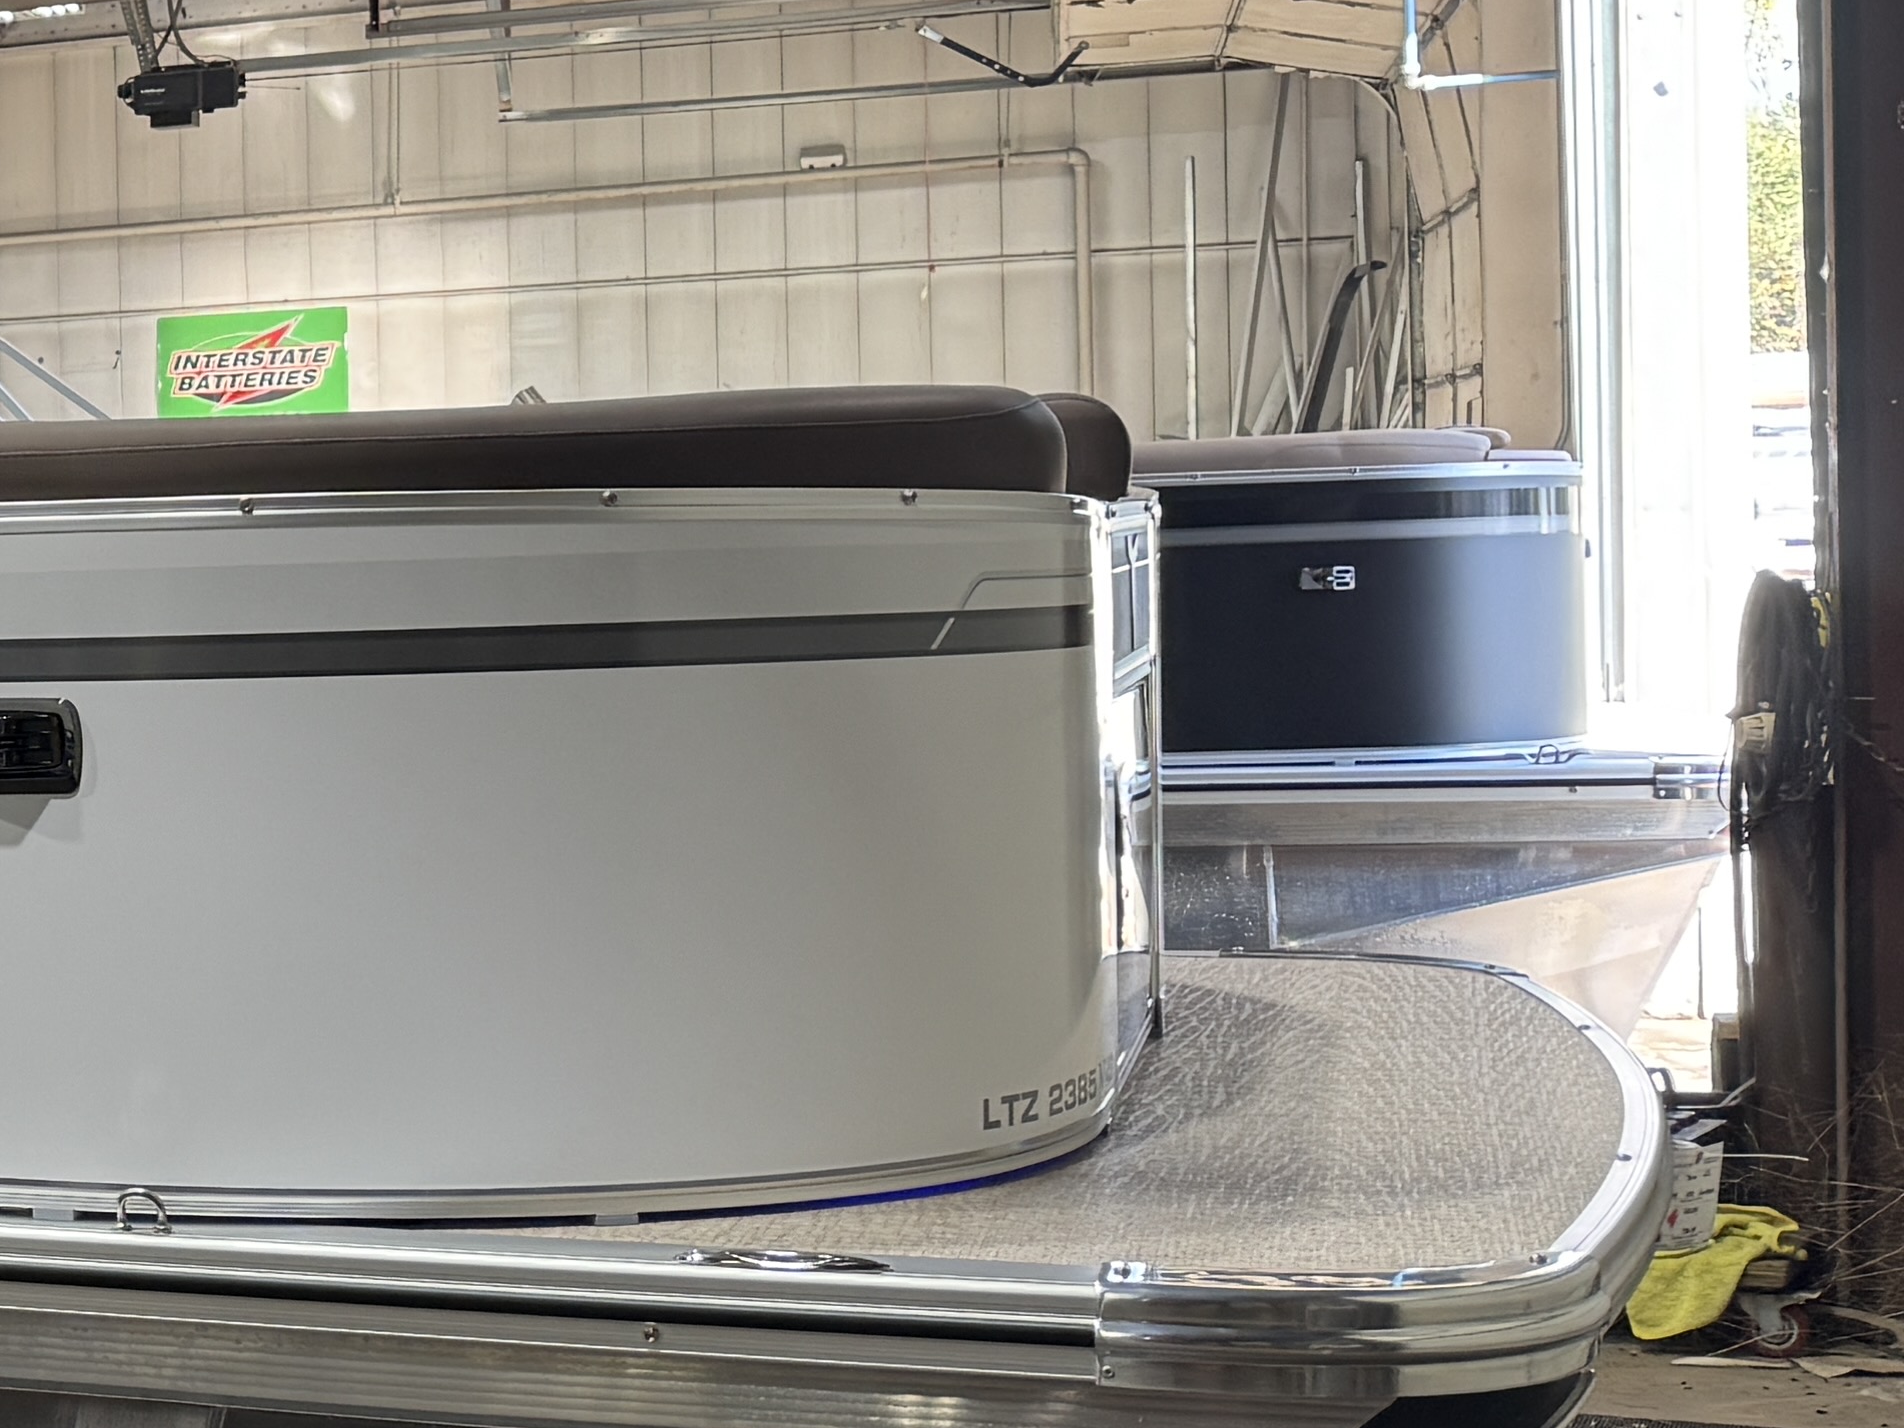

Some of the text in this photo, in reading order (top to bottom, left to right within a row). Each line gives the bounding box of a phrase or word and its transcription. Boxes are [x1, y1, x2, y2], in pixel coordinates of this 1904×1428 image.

[173, 346, 329, 372] INTERSTATE
[178, 368, 318, 392] BATTERIES
[982, 1089, 1039, 1131] LTZ
[1049, 1068, 1097, 1117] 2385
